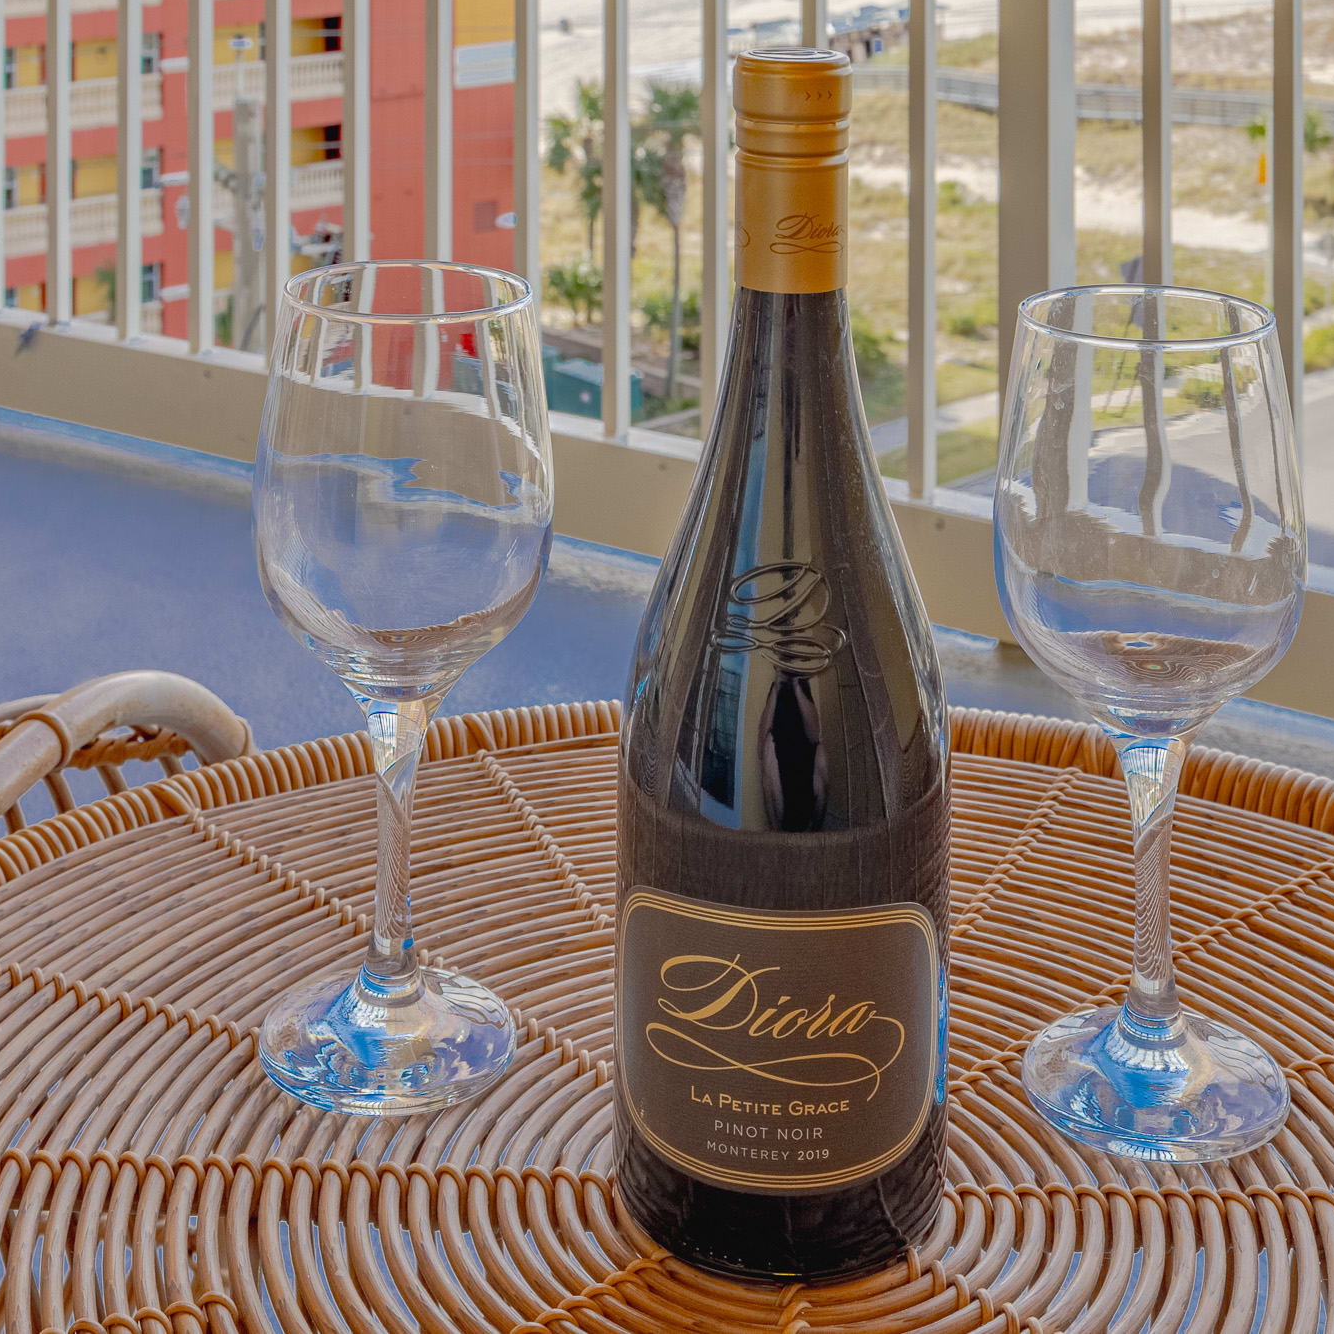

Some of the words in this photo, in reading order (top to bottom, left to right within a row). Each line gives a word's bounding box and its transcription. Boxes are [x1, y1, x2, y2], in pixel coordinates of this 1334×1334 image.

[658, 953, 905, 1040] Diora
[690, 1085, 713, 1106] LA
[719, 1093, 782, 1116] PETITE
[788, 1099, 850, 1116] GRACE
[714, 1119, 768, 1139] PINOT
[777, 1127, 823, 1141] NOIR
[706, 1140, 790, 1161] MONTEREY
[797, 1148, 830, 1161] 2019
